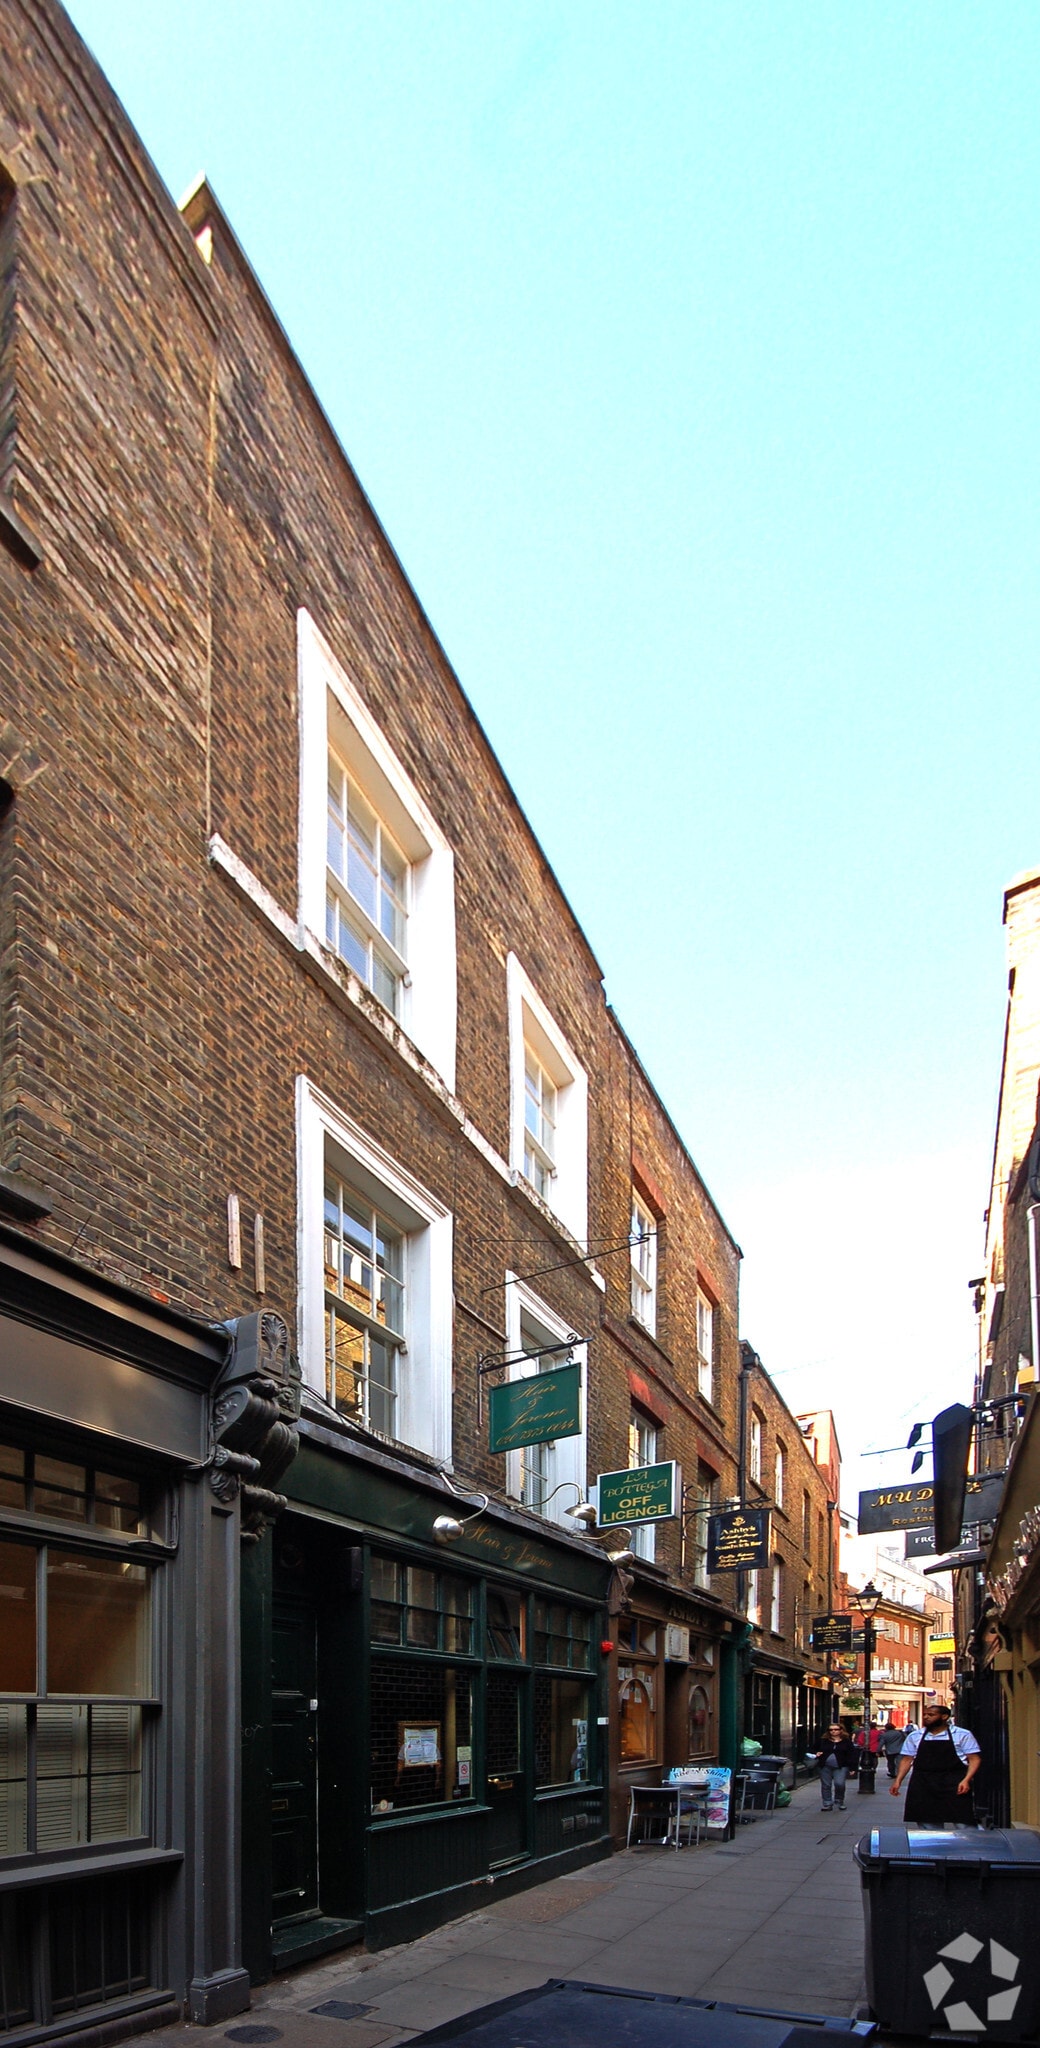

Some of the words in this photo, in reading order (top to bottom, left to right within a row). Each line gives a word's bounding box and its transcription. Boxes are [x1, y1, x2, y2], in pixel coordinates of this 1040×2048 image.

[511, 1379, 557, 1402] Hair
[622, 1471, 649, 1484] LA
[603, 1479, 668, 1498] BOTTEGA
[619, 1495, 652, 1509] OFF
[602, 1503, 668, 1523] LICENCE
